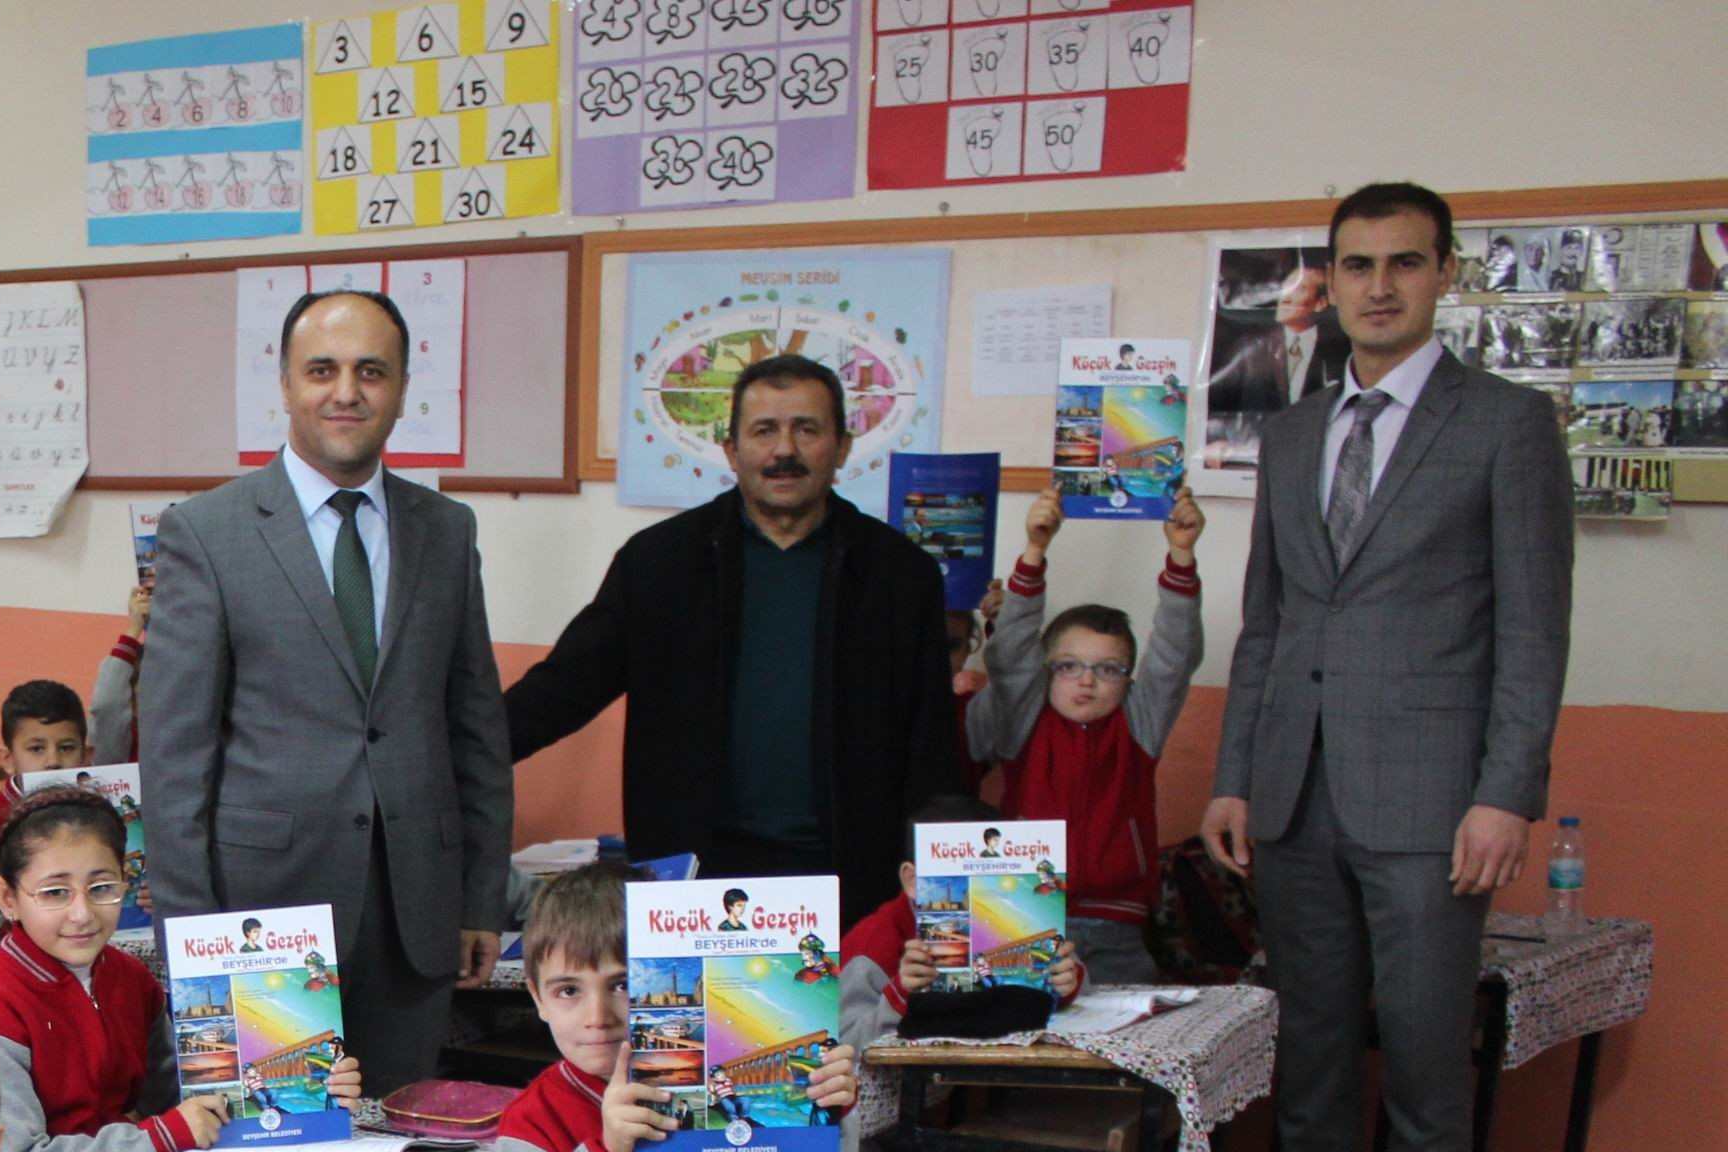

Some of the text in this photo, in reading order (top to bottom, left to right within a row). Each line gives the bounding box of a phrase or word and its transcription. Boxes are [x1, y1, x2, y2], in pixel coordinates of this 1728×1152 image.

[508, 12, 526, 44] 9
[602, 6, 616, 28] 4
[668, 3, 680, 28] 8
[335, 36, 349, 64] 3
[418, 23, 433, 53] 6
[1129, 36, 1162, 58] 40
[970, 50, 999, 73] 30
[1048, 42, 1080, 66] 35
[725, 66, 756, 92] 28
[895, 56, 922, 78] 25
[456, 79, 488, 108] 15
[594, 80, 624, 105] 20
[658, 80, 689, 106] 24
[796, 67, 829, 95] 32
[151, 106, 162, 124] 4
[191, 104, 204, 122] 6
[238, 100, 248, 120] 8
[371, 89, 401, 117] 12
[115, 110, 126, 128] 2
[501, 126, 536, 156] 24
[965, 128, 994, 150] 45
[1044, 124, 1074, 146] 50
[330, 146, 357, 173] 18
[410, 138, 441, 166] 21
[722, 150, 756, 174] 40
[368, 199, 399, 225] 27
[458, 190, 492, 218] 30
[423, 272, 432, 286] 3
[420, 341, 429, 352] 6
[420, 402, 429, 415] 9
[648, 904, 818, 939] Küçük Gezgin
[184, 928, 318, 962] Küçük Gezgin
